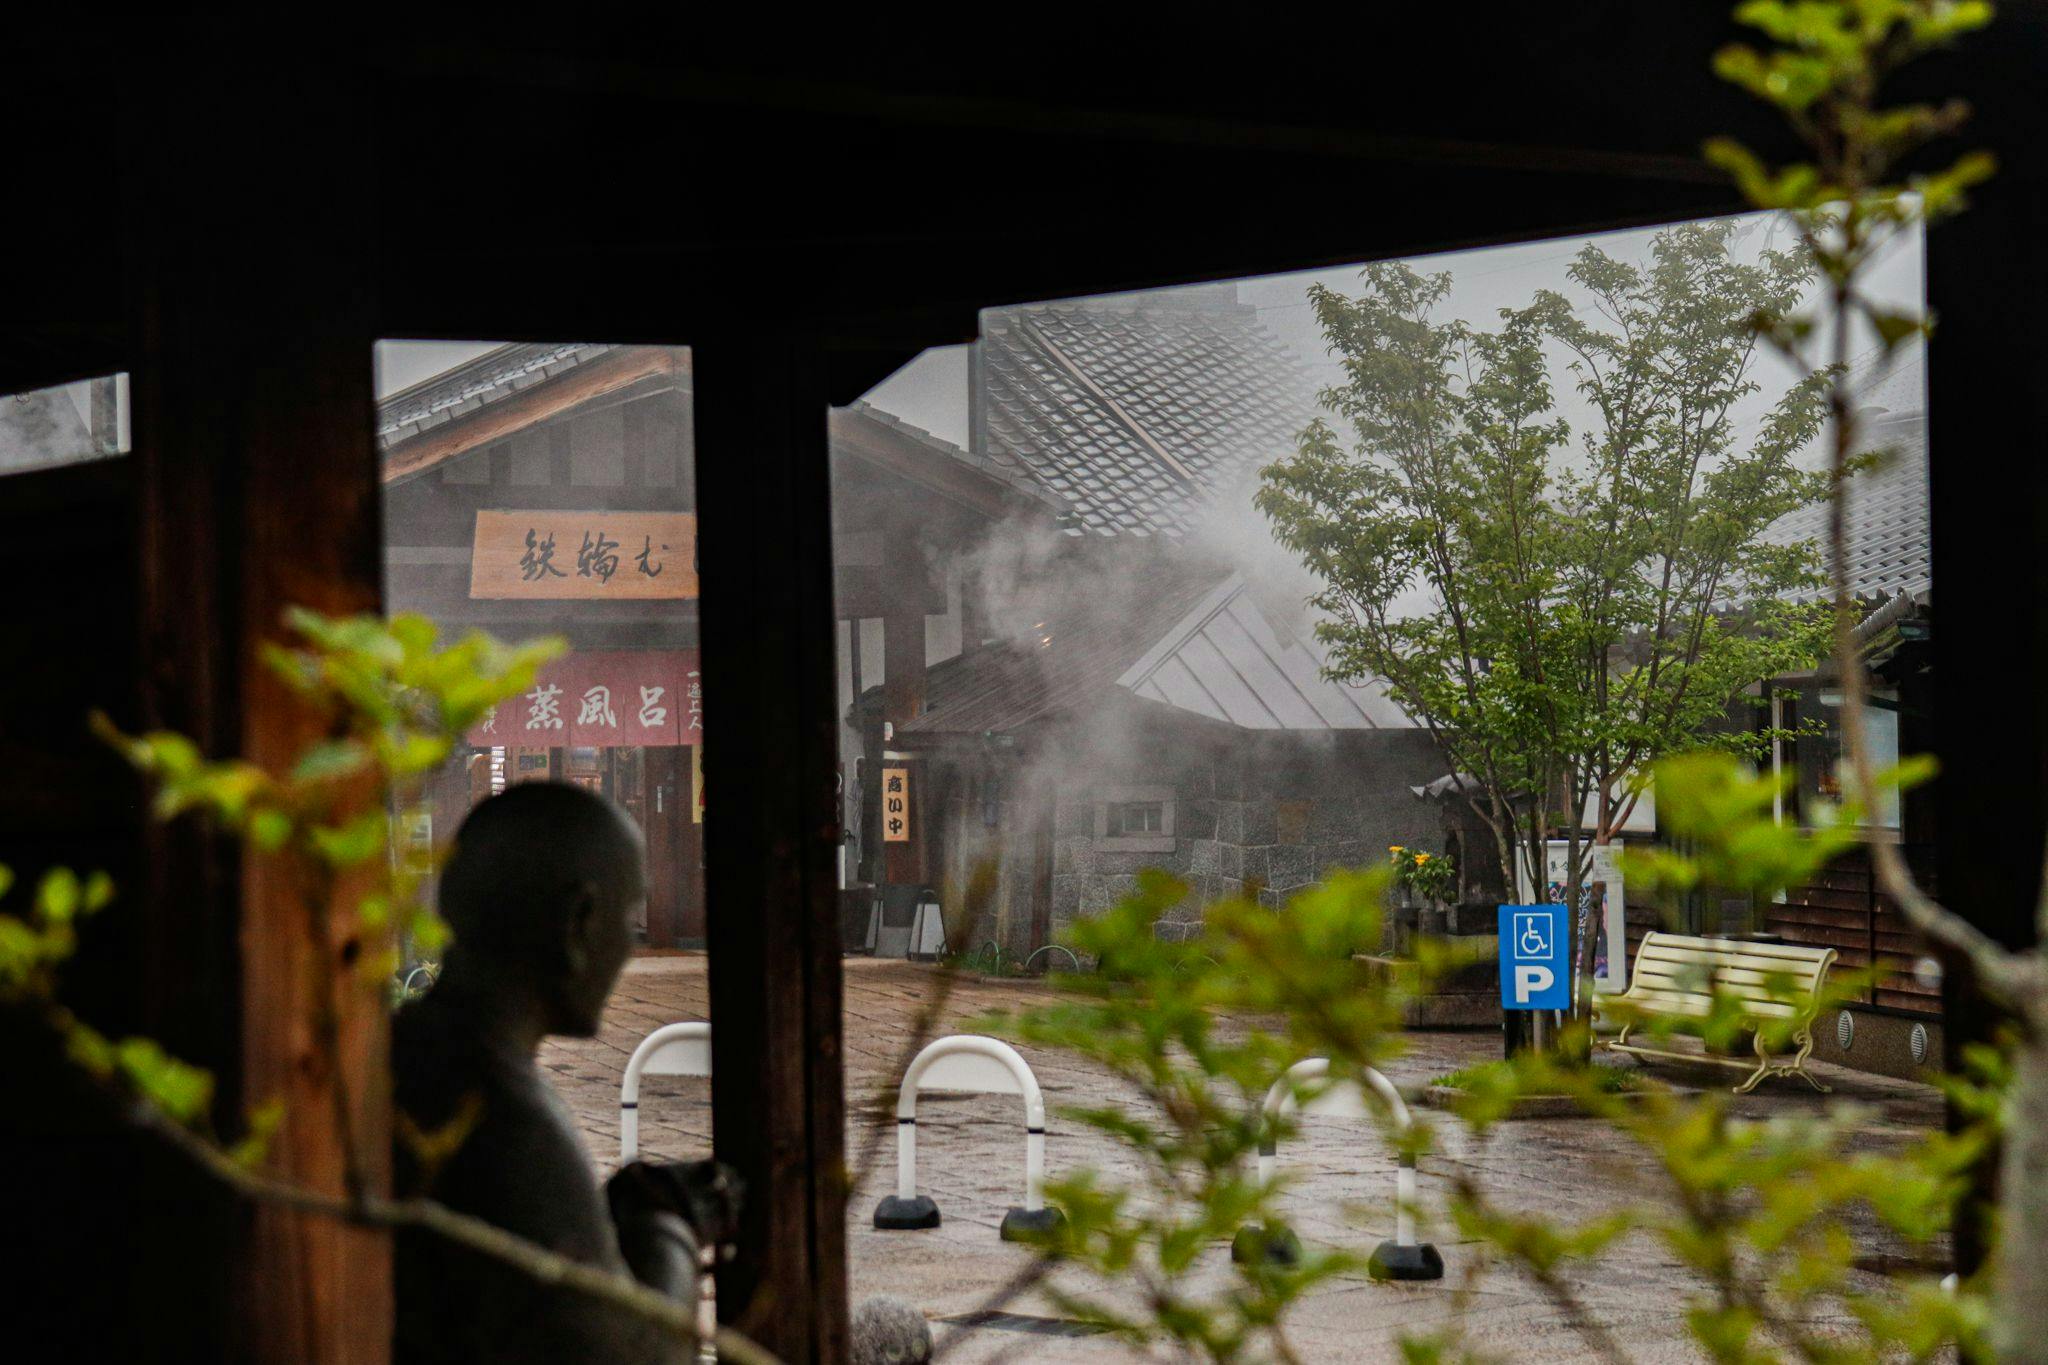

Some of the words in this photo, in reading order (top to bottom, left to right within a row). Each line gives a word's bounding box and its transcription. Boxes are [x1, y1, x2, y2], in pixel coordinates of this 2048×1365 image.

[525, 683, 668, 731] 蒸風呂
[888, 775, 903, 834] 商い中
[1515, 965, 1555, 1003] P
